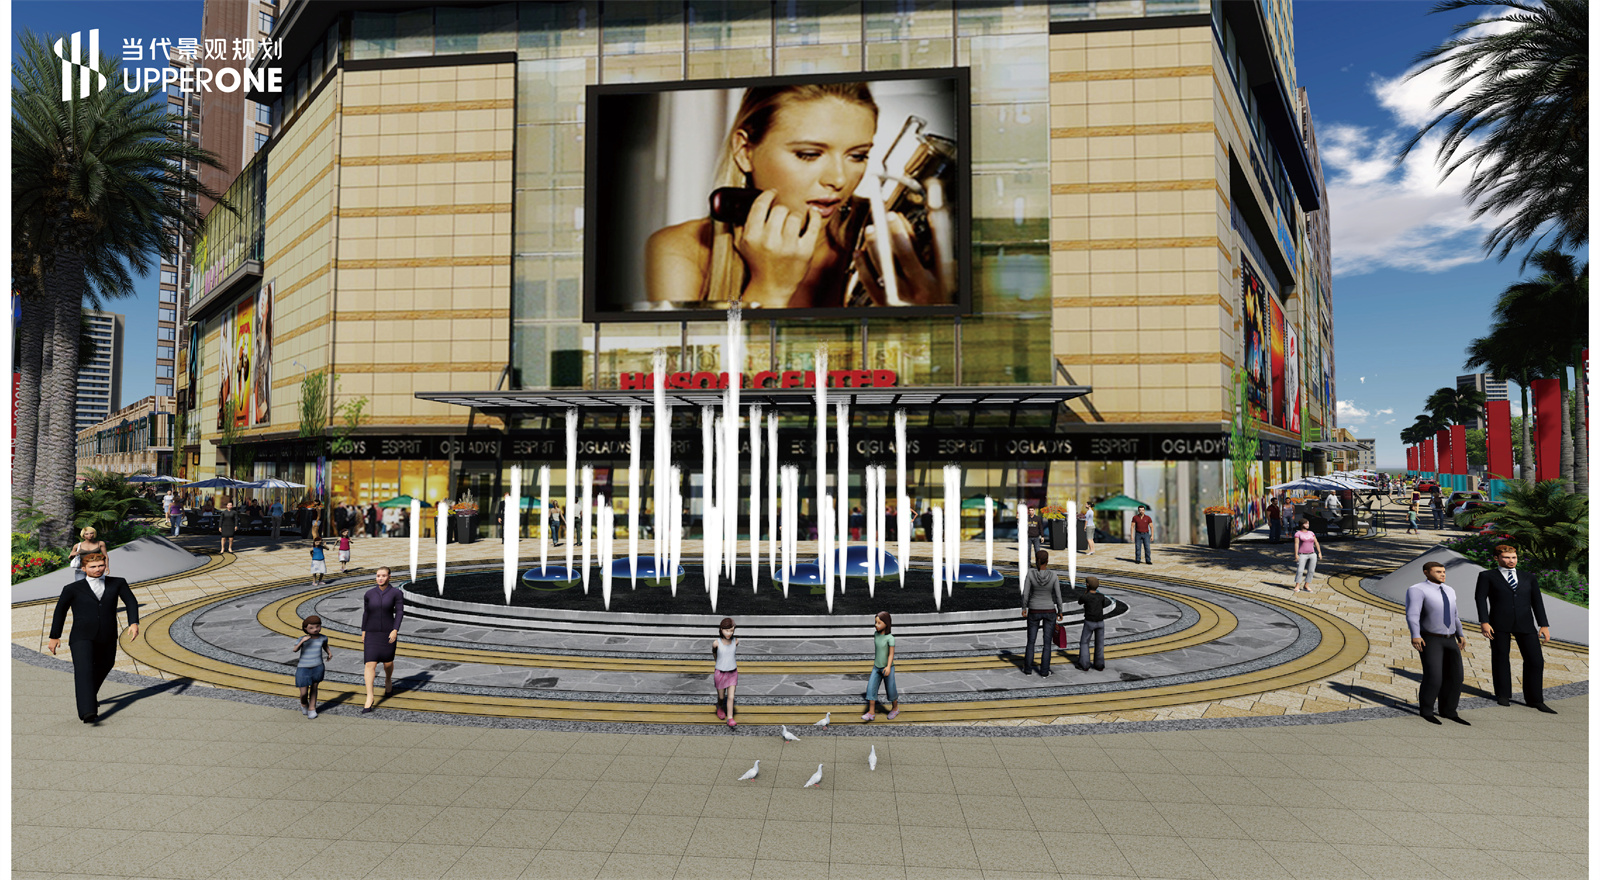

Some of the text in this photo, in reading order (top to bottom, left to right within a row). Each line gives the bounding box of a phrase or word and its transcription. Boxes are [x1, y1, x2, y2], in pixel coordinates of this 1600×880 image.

[381, 439, 422, 454] ESPRIT
[1006, 439, 1073, 454] OGLADYS
[1091, 438, 1140, 454] ESPRIT
